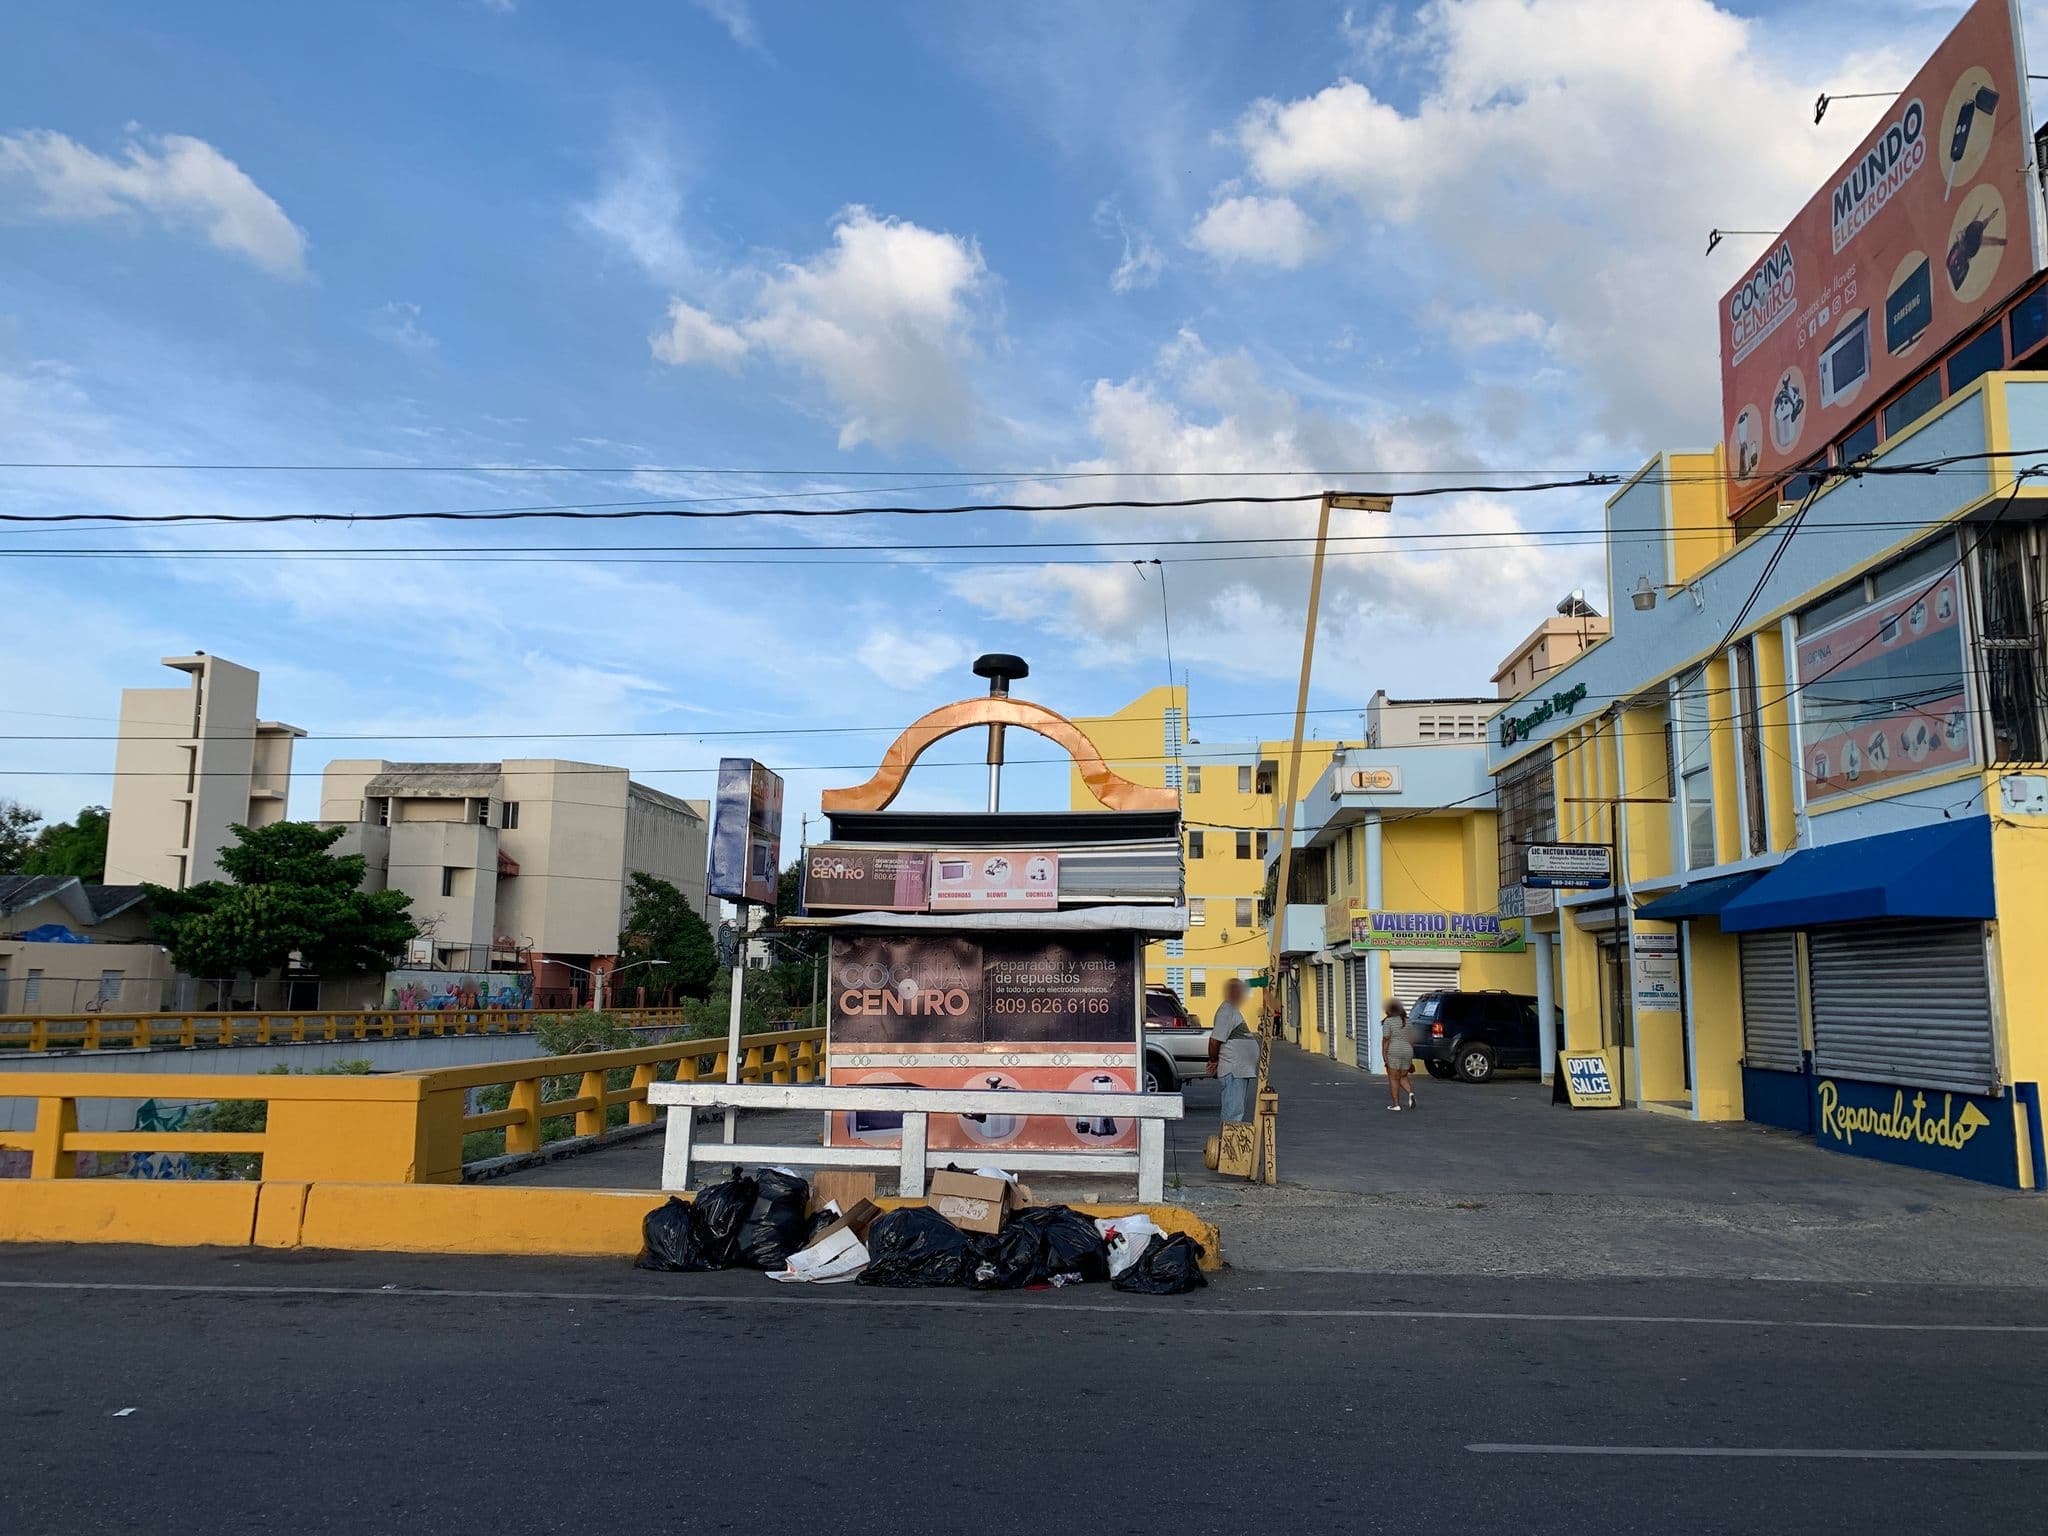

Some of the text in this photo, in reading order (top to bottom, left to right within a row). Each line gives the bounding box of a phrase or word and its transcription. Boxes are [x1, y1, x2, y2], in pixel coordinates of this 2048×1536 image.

[1833, 102, 1924, 227] MUNDO
[1731, 242, 1793, 322] COCINA
[1796, 263, 1857, 329] copias de llaves
[1732, 269, 1795, 349] CENTRO
[1543, 848, 1565, 856] HECTOR
[1565, 848, 1587, 857] VARGAS
[812, 857, 865, 869] COCINA
[811, 867, 865, 880] CENTRO
[1371, 912, 1448, 933] VALERIO
[1450, 912, 1500, 933] PACA
[1449, 932, 1477, 940] PACAS
[1068, 961, 1076, 973] y
[1080, 960, 1116, 971] venta
[839, 962, 970, 990] COCINA
[995, 973, 1080, 986] de repuestos
[1023, 986, 1035, 994] tipo
[839, 988, 970, 1016] CENTRO
[995, 998, 1110, 1014] 809.626.6166
[1567, 1058, 1607, 1075] OPTICA
[1572, 1076, 1611, 1094] SALCE
[1817, 1080, 1968, 1150] Reparalotodo
